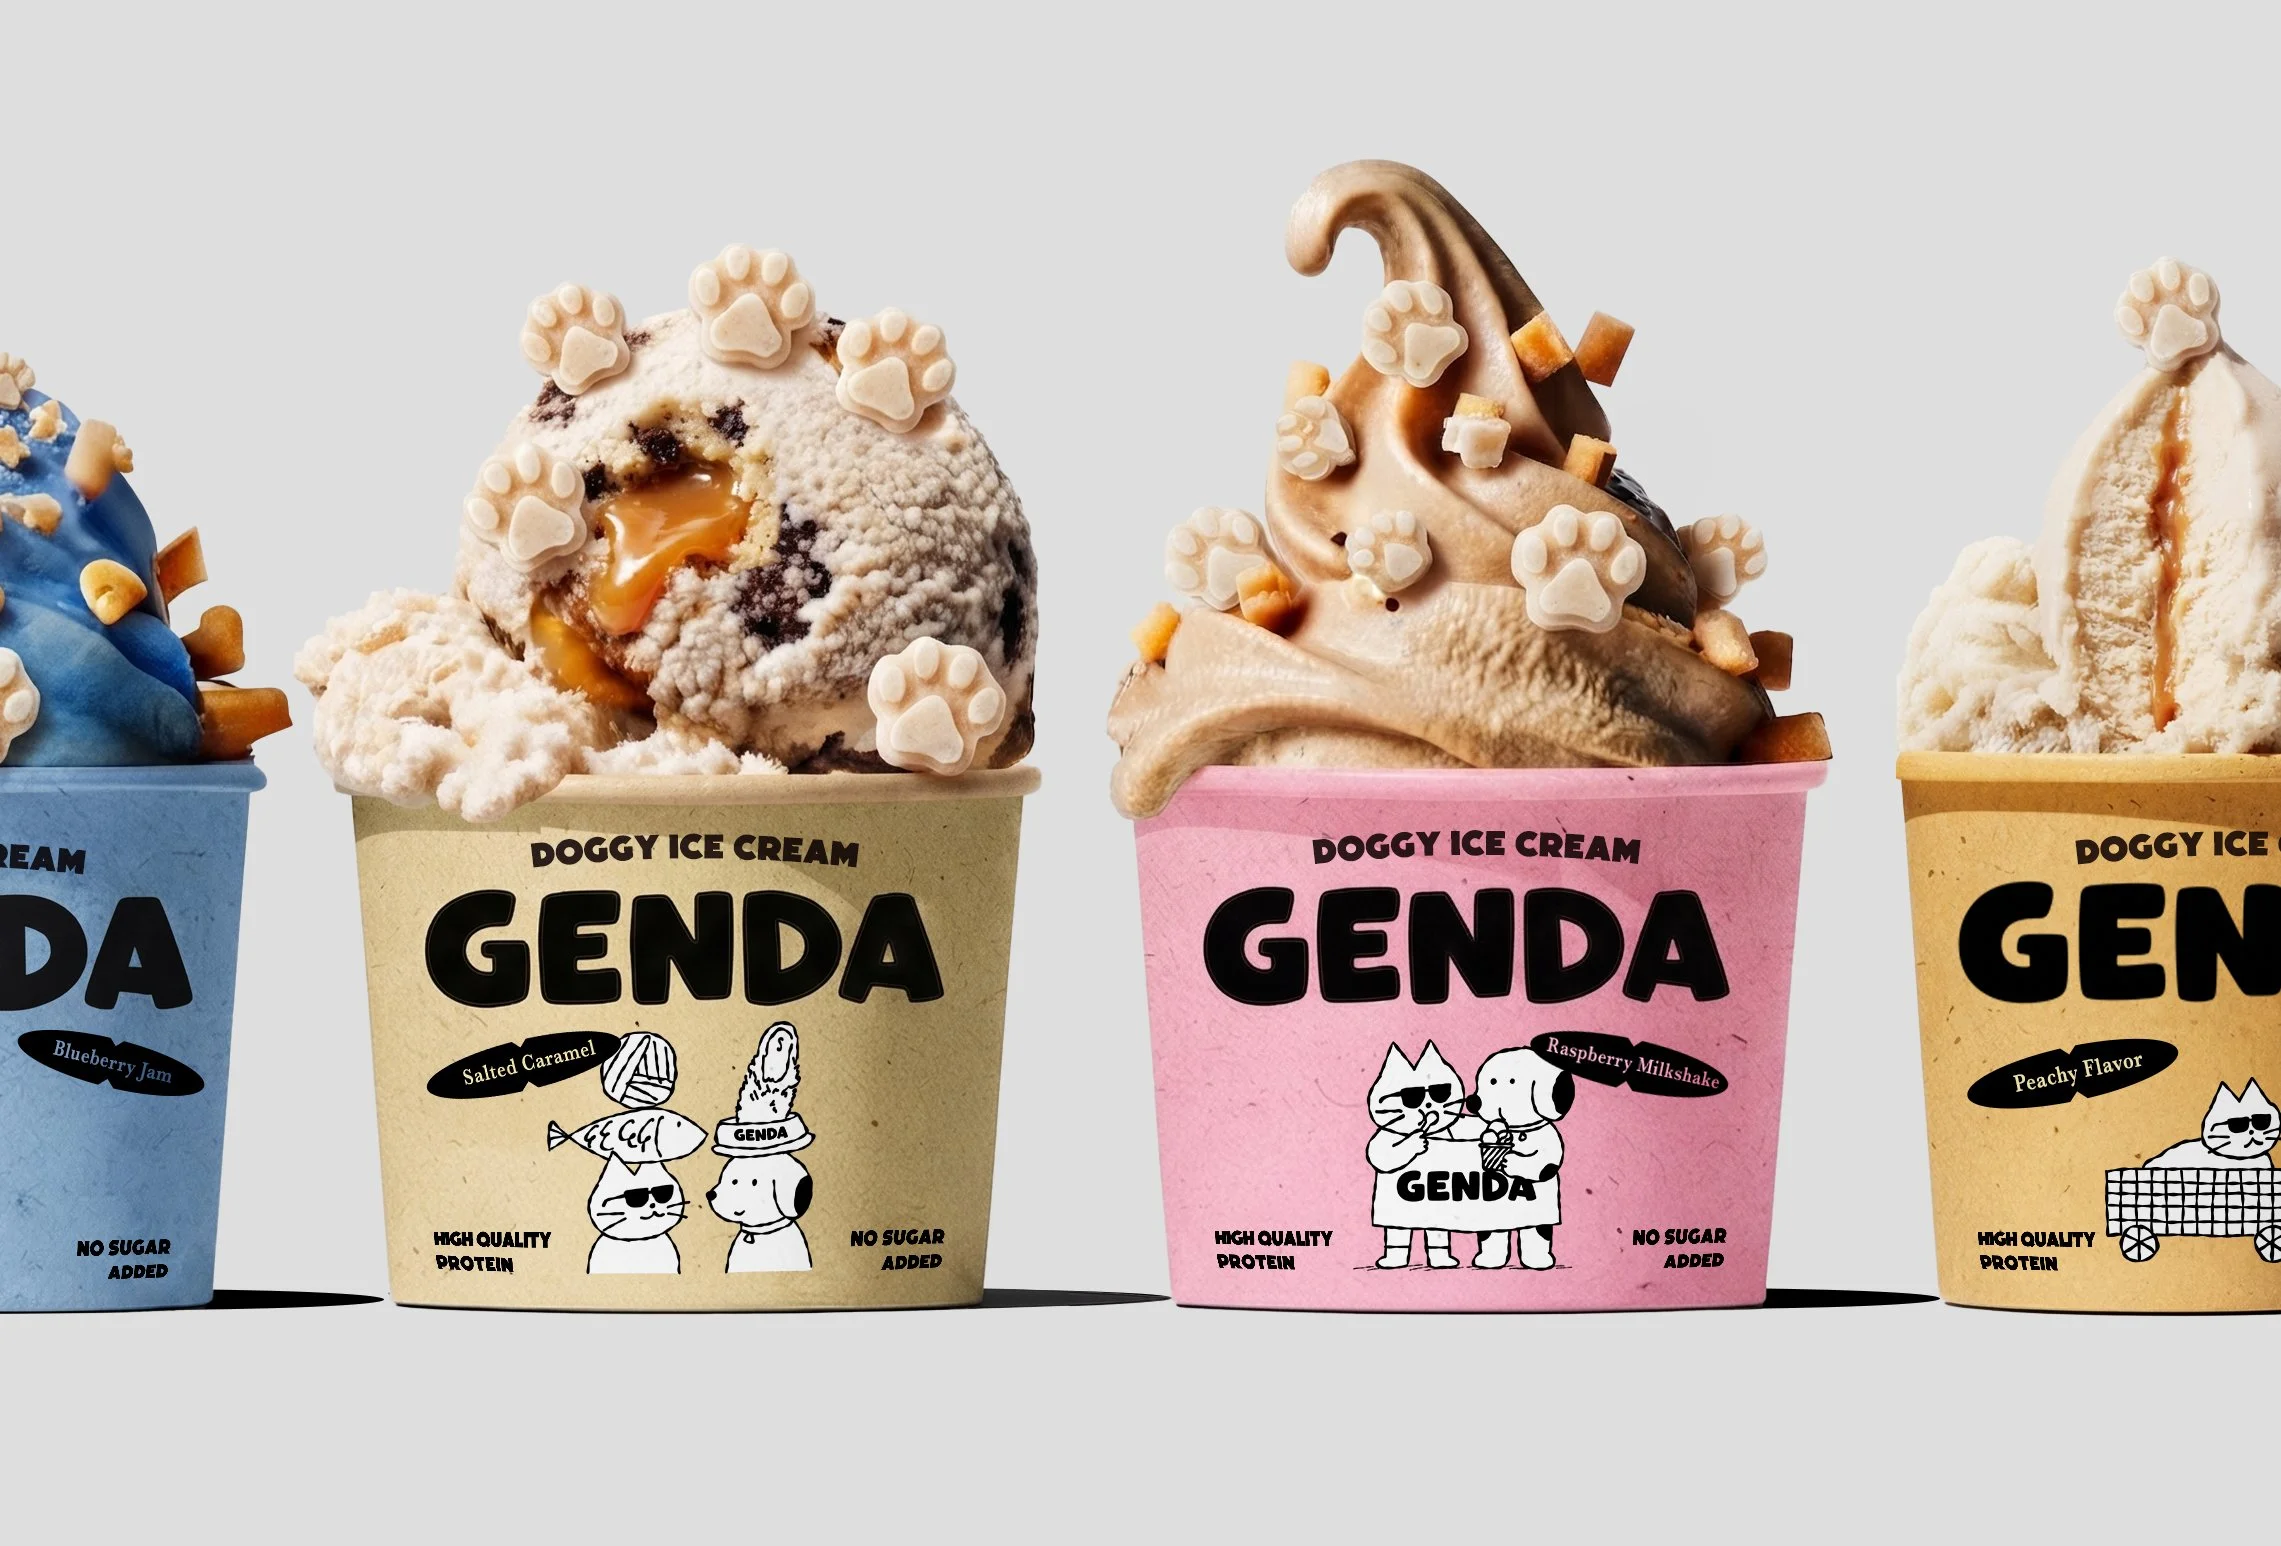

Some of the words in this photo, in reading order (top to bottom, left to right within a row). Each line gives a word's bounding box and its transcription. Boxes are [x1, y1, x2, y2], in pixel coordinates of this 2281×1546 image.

[531, 835, 659, 867] DOGGY
[669, 834, 723, 859] ICE
[734, 835, 859, 867] CREAM
[1313, 832, 1440, 864] DOGGY
[1451, 830, 1505, 856] ICE
[1516, 831, 1640, 864] CREAM
[2076, 832, 2203, 864] DOGGY
[2214, 831, 2268, 856] ICE
[425, 890, 944, 1008] GENDA
[1204, 887, 1730, 1006] GENDA
[1959, 882, 2281, 1003] GEN
[0, 894, 193, 1011] DA
[53, 1040, 136, 1077] Blueberry
[136, 1062, 172, 1084] Jam
[463, 1058, 518, 1085] Salted
[522, 1040, 596, 1070] Caramel
[1547, 1037, 1632, 1073] Raspberry
[1637, 1057, 1719, 1088] Milkshake
[2013, 1066, 2077, 1092] Peachy
[2082, 1055, 2142, 1077] Flavor
[733, 1126, 788, 1141] GENDA
[1396, 1170, 1537, 1202] GENDA
[434, 1231, 473, 1246] HIGH
[477, 1232, 551, 1248] QUALITY
[851, 1230, 879, 1246] NO
[882, 1229, 945, 1246] SUGAR
[1215, 1230, 1254, 1245] HIGH
[1258, 1231, 1333, 1246] QUALITY
[1633, 1229, 1660, 1245] NO
[1664, 1228, 1727, 1245] SUGAR
[1978, 1231, 2017, 1246] HIGH
[2021, 1232, 2095, 1247] QUALITY
[77, 1240, 104, 1256] NO
[108, 1239, 171, 1256] SUGAR
[436, 1255, 513, 1272] PROTEIN
[881, 1254, 942, 1270] ADDED
[1217, 1254, 1295, 1269] PROTEIN
[1664, 1253, 1724, 1268] ADDED
[1980, 1255, 2058, 1270] PROTEIN
[108, 1264, 168, 1279] ADDED
